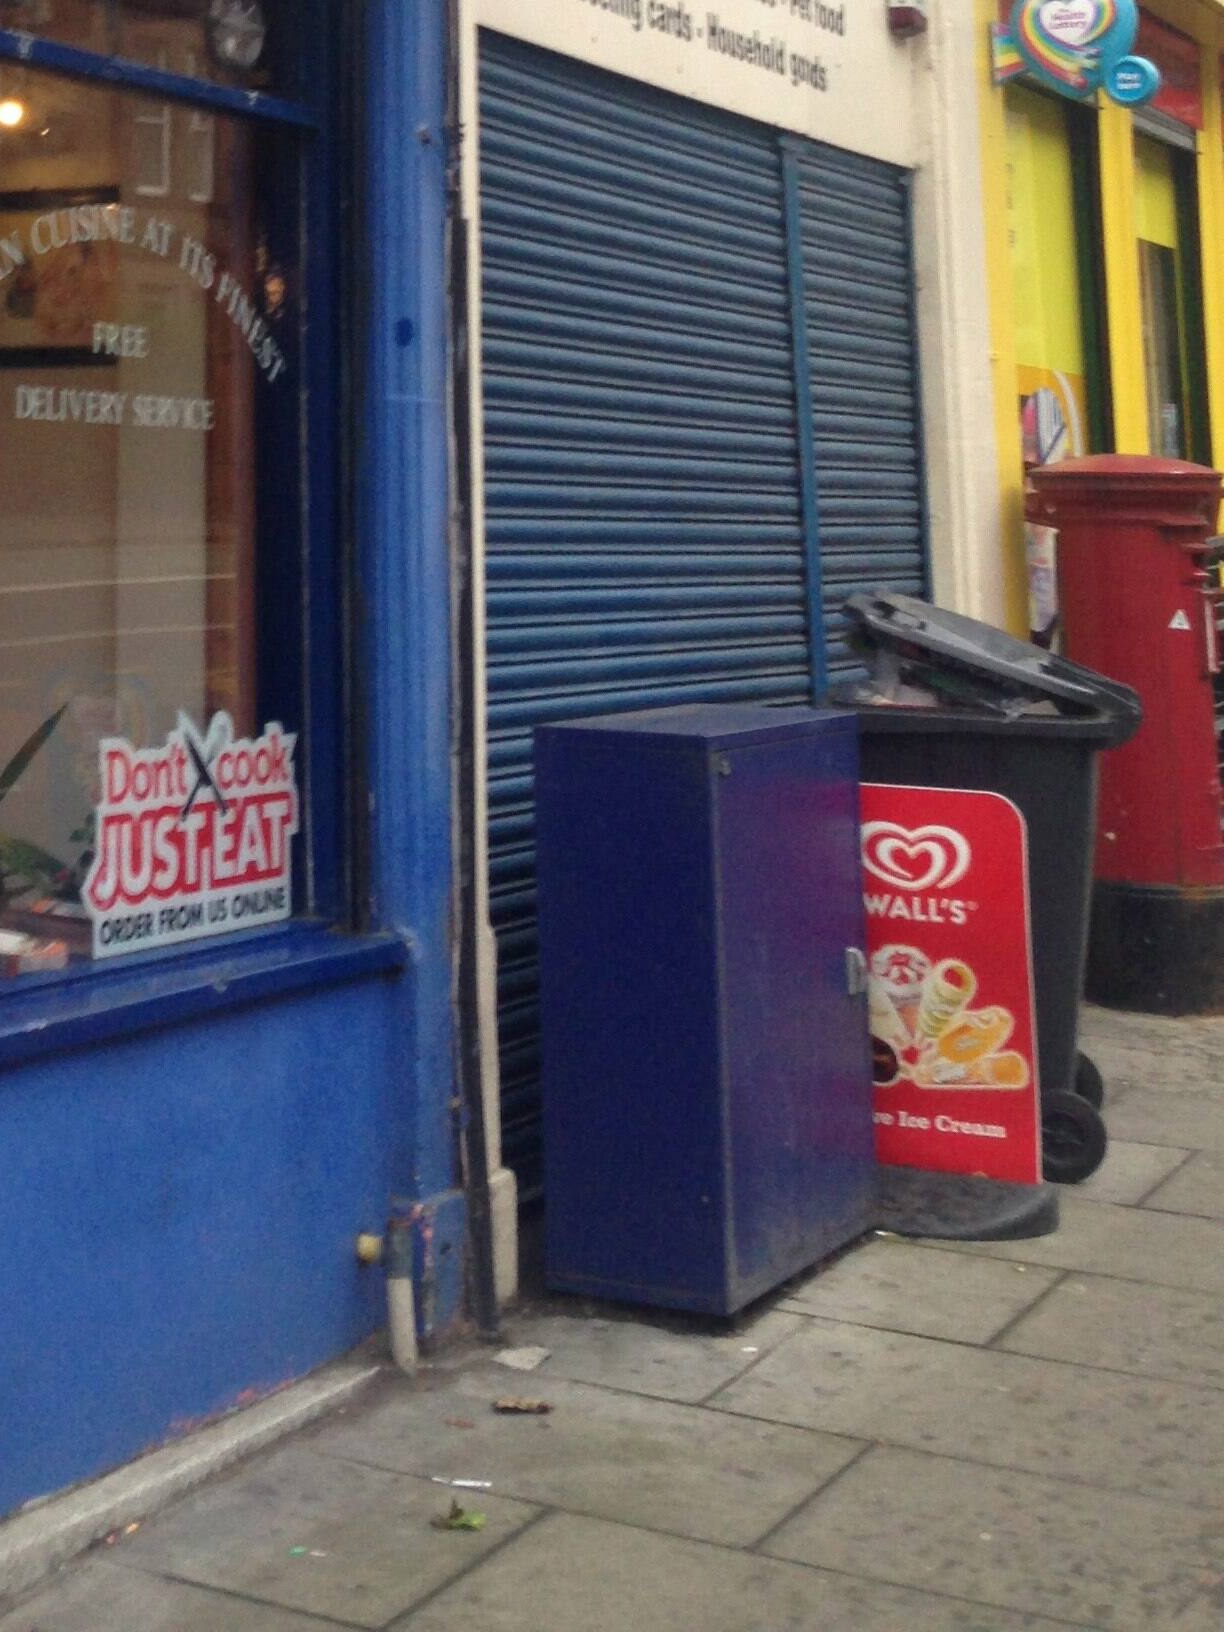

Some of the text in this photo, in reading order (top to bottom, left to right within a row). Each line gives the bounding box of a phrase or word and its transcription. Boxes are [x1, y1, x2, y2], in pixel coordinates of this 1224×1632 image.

[647, 0, 693, 43] cards
[707, 11, 785, 76] Household
[790, 52, 828, 94] goods
[140, 217, 176, 258] AT
[92, 319, 153, 359] FREE
[15, 383, 216, 431] DELIVERY SERVICE
[214, 732, 290, 791] cook
[90, 801, 293, 906] JUST EAT
[99, 886, 286, 947] ORDER FROM US ONLINE
[862, 892, 968, 925] WALL'S
[898, 1110, 930, 1130] Ice
[934, 1114, 1008, 1139] Cream
